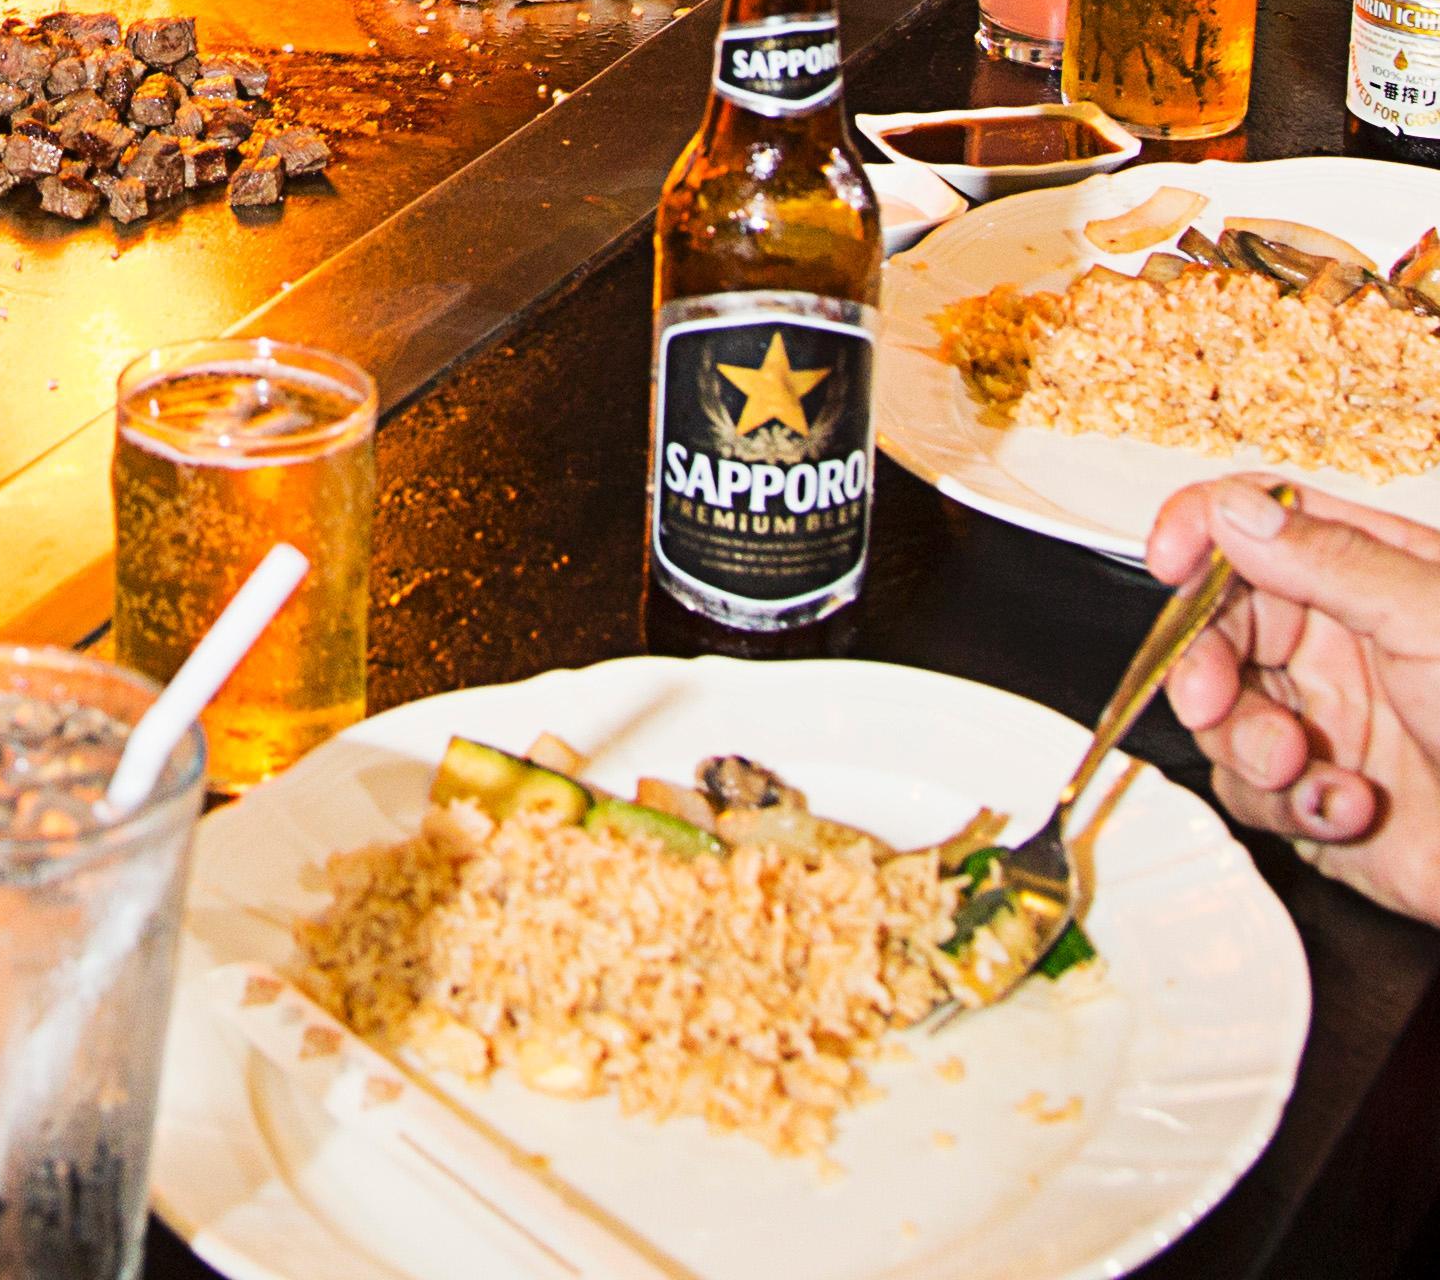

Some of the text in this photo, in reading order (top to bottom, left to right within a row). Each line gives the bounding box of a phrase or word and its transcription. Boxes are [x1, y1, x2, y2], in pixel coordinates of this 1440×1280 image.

[732, 40, 840, 79] SAPPOR
[1373, 102, 1400, 123] FOR
[665, 442, 866, 514] SAPPORO
[668, 493, 797, 535] PREMIUM
